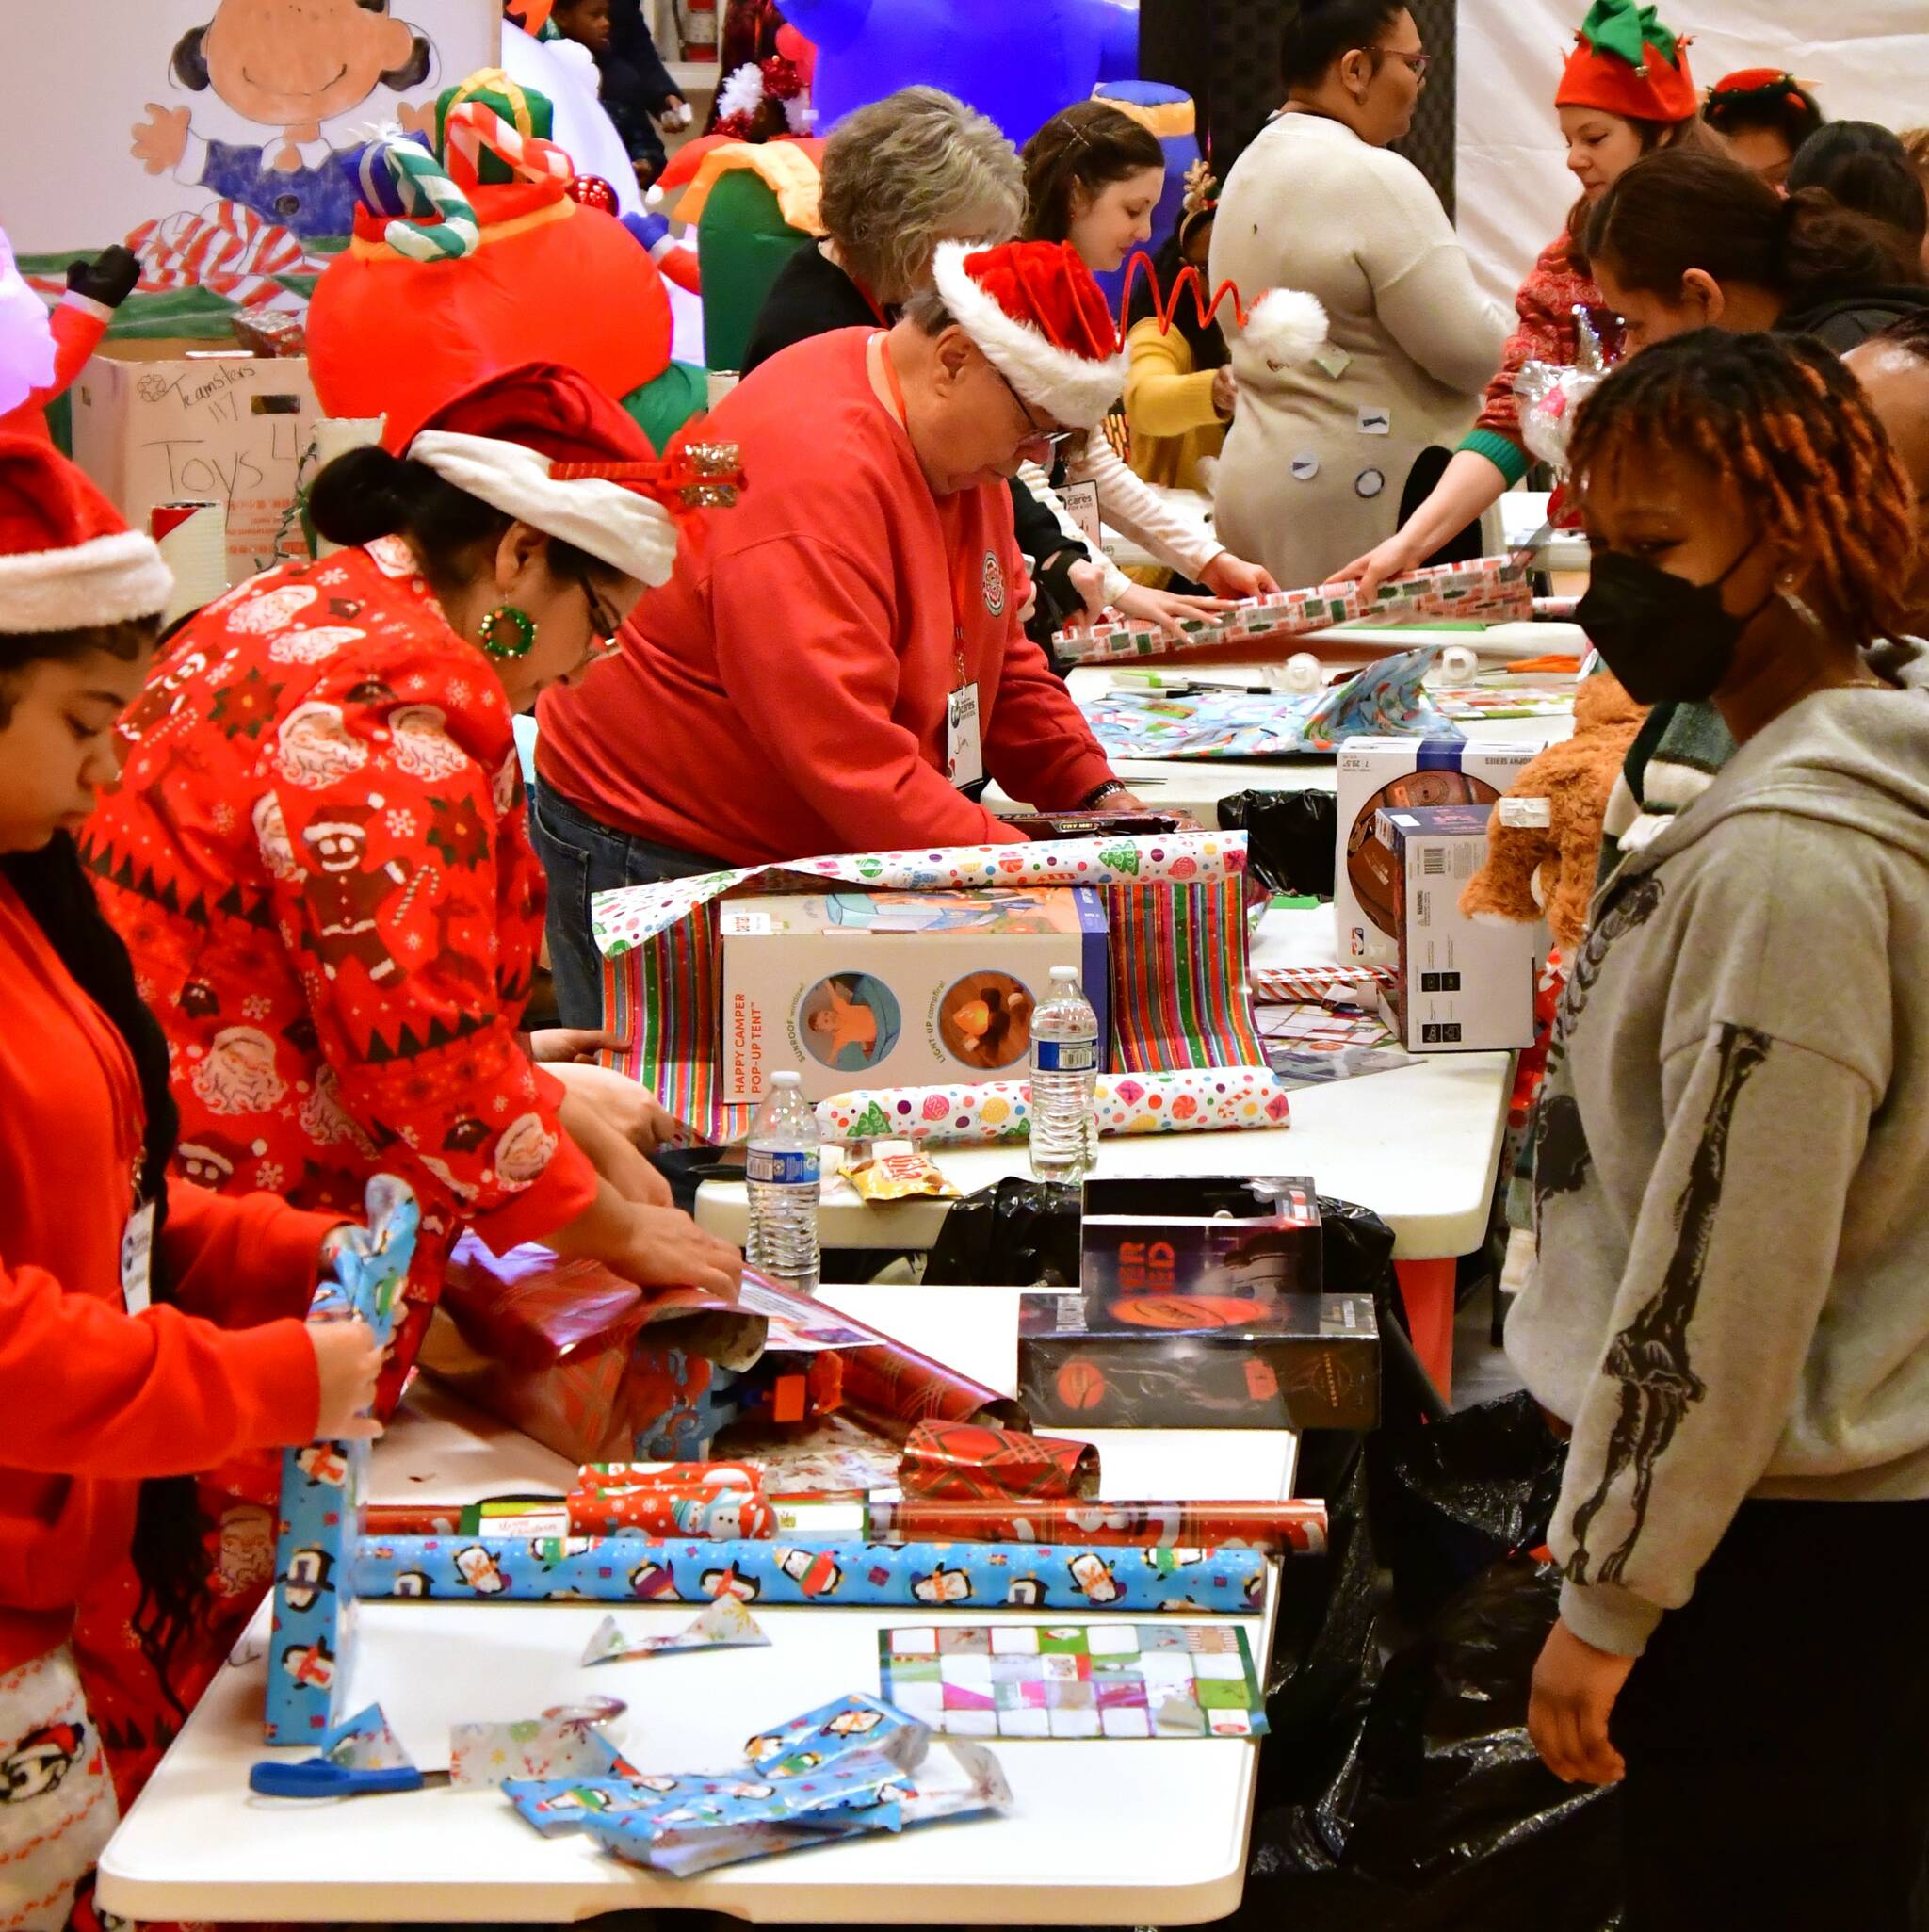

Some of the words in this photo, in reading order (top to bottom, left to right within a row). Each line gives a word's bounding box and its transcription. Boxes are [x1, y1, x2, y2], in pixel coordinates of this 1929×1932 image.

[162, 364, 256, 409] Teamsters
[140, 439, 264, 529] Toys
[1067, 495, 1093, 506] cares
[735, 993, 745, 1048] CAMPER
[787, 1019, 806, 1063] SUNROOF
[926, 1021, 947, 1063] LIGHT-UP
[735, 1051, 745, 1094] HAPPY
[751, 1043, 761, 1094] POP-UP
